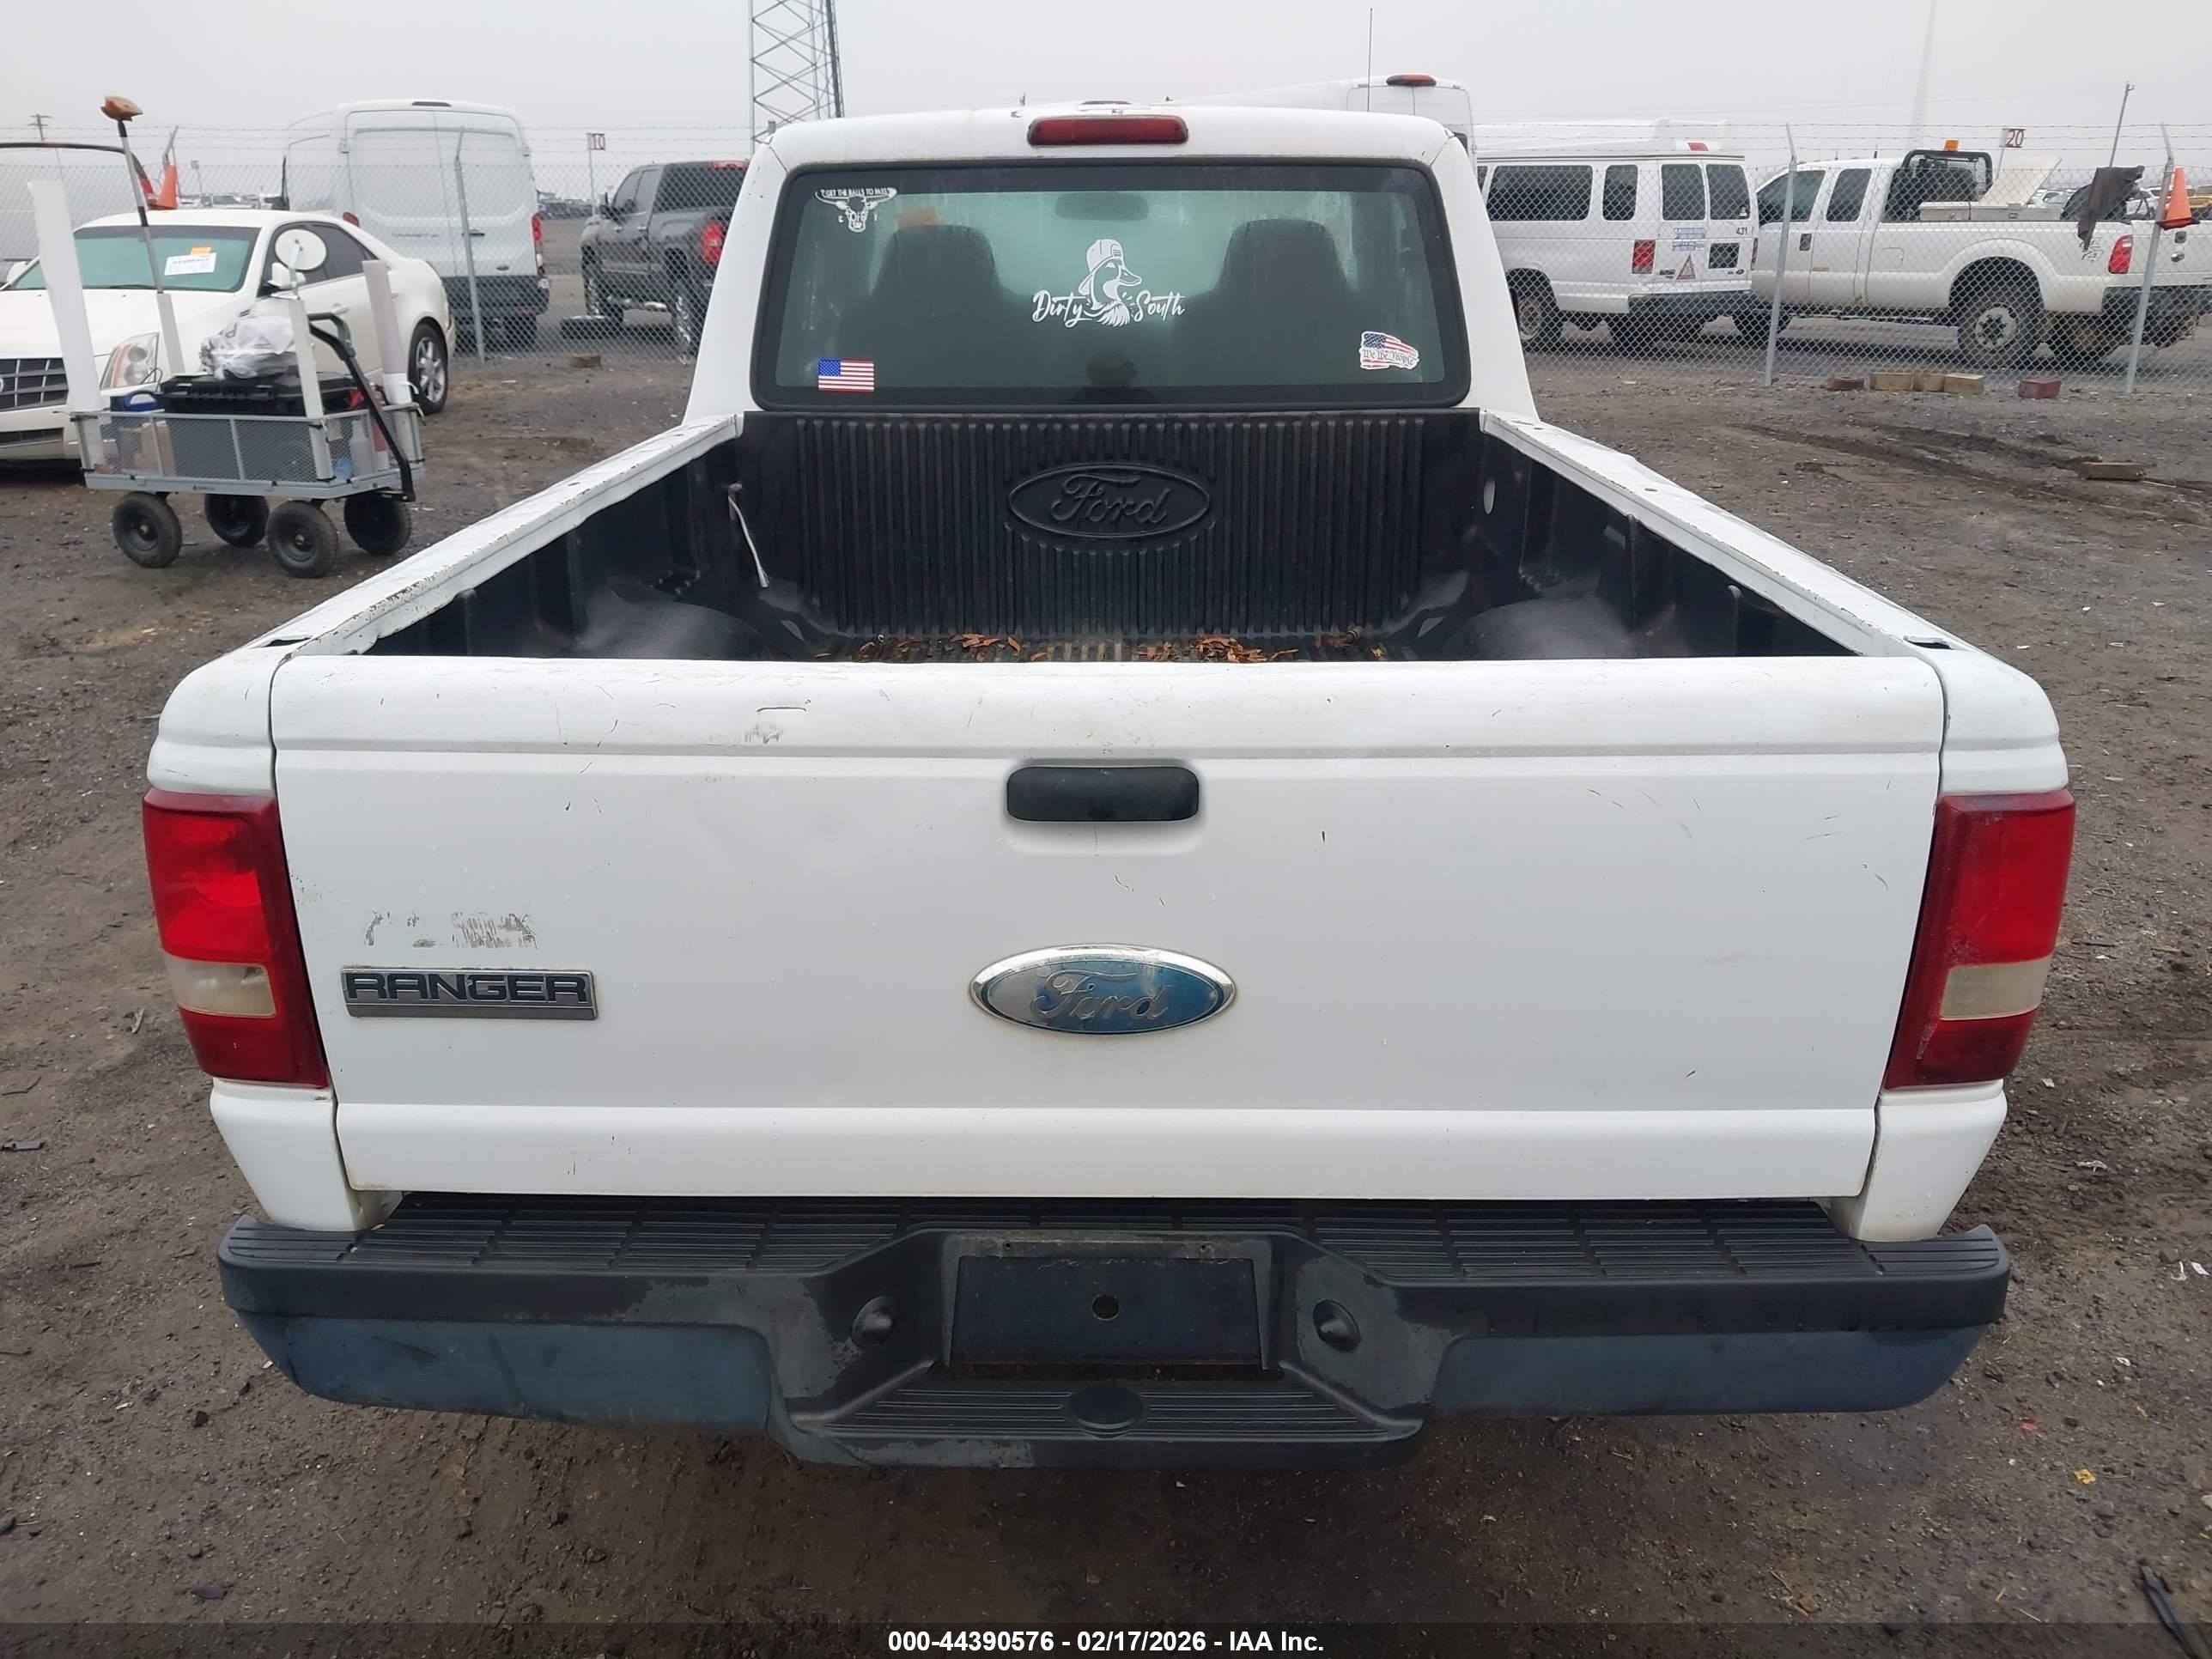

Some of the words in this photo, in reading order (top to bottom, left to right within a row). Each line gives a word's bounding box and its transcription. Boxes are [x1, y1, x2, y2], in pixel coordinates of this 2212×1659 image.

[592, 133, 606, 150] 10
[2006, 129, 2025, 147] 20
[1032, 289, 1093, 328] Dirty
[1133, 289, 1185, 323] South
[1050, 474, 1171, 524] Ford
[345, 972, 589, 1005] RANGER
[1030, 969, 1174, 1020] Ford
